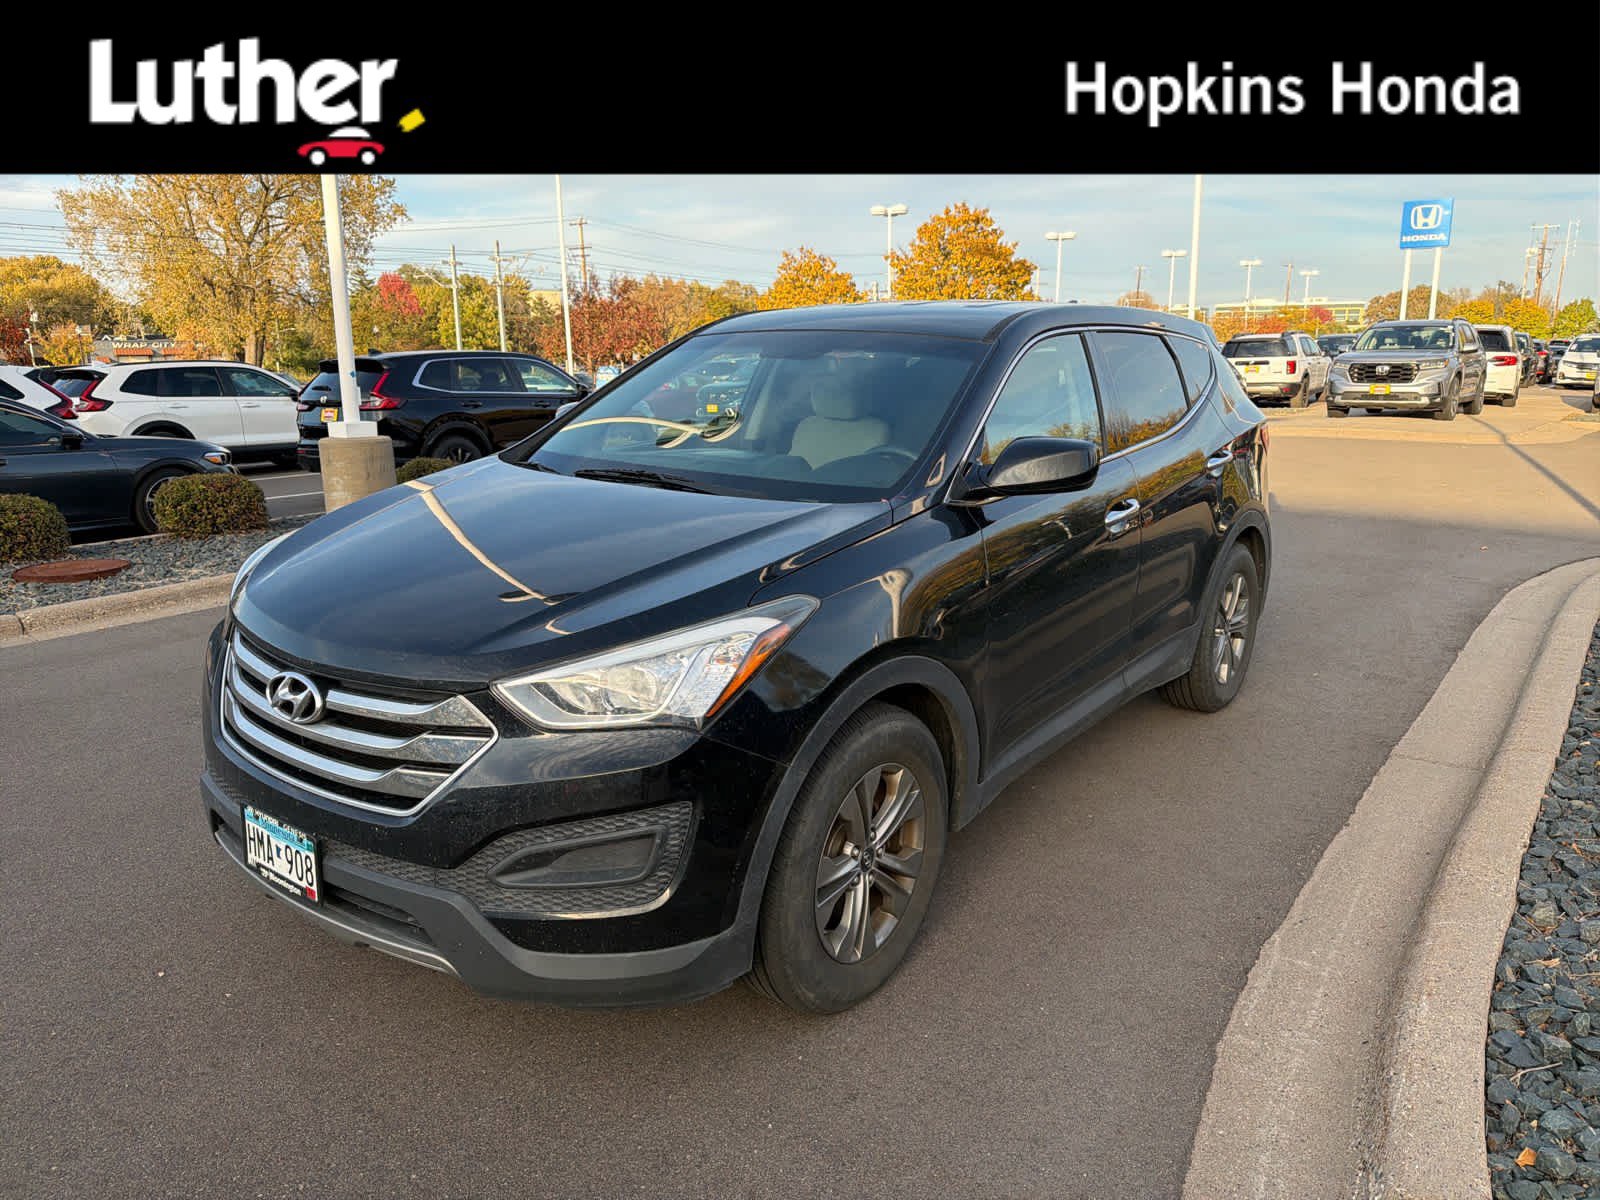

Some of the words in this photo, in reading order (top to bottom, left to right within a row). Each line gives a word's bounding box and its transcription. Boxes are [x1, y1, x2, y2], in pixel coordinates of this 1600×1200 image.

[1402, 233, 1446, 242] HONDA
[247, 823, 275, 866] HMA
[285, 845, 314, 887] 908
